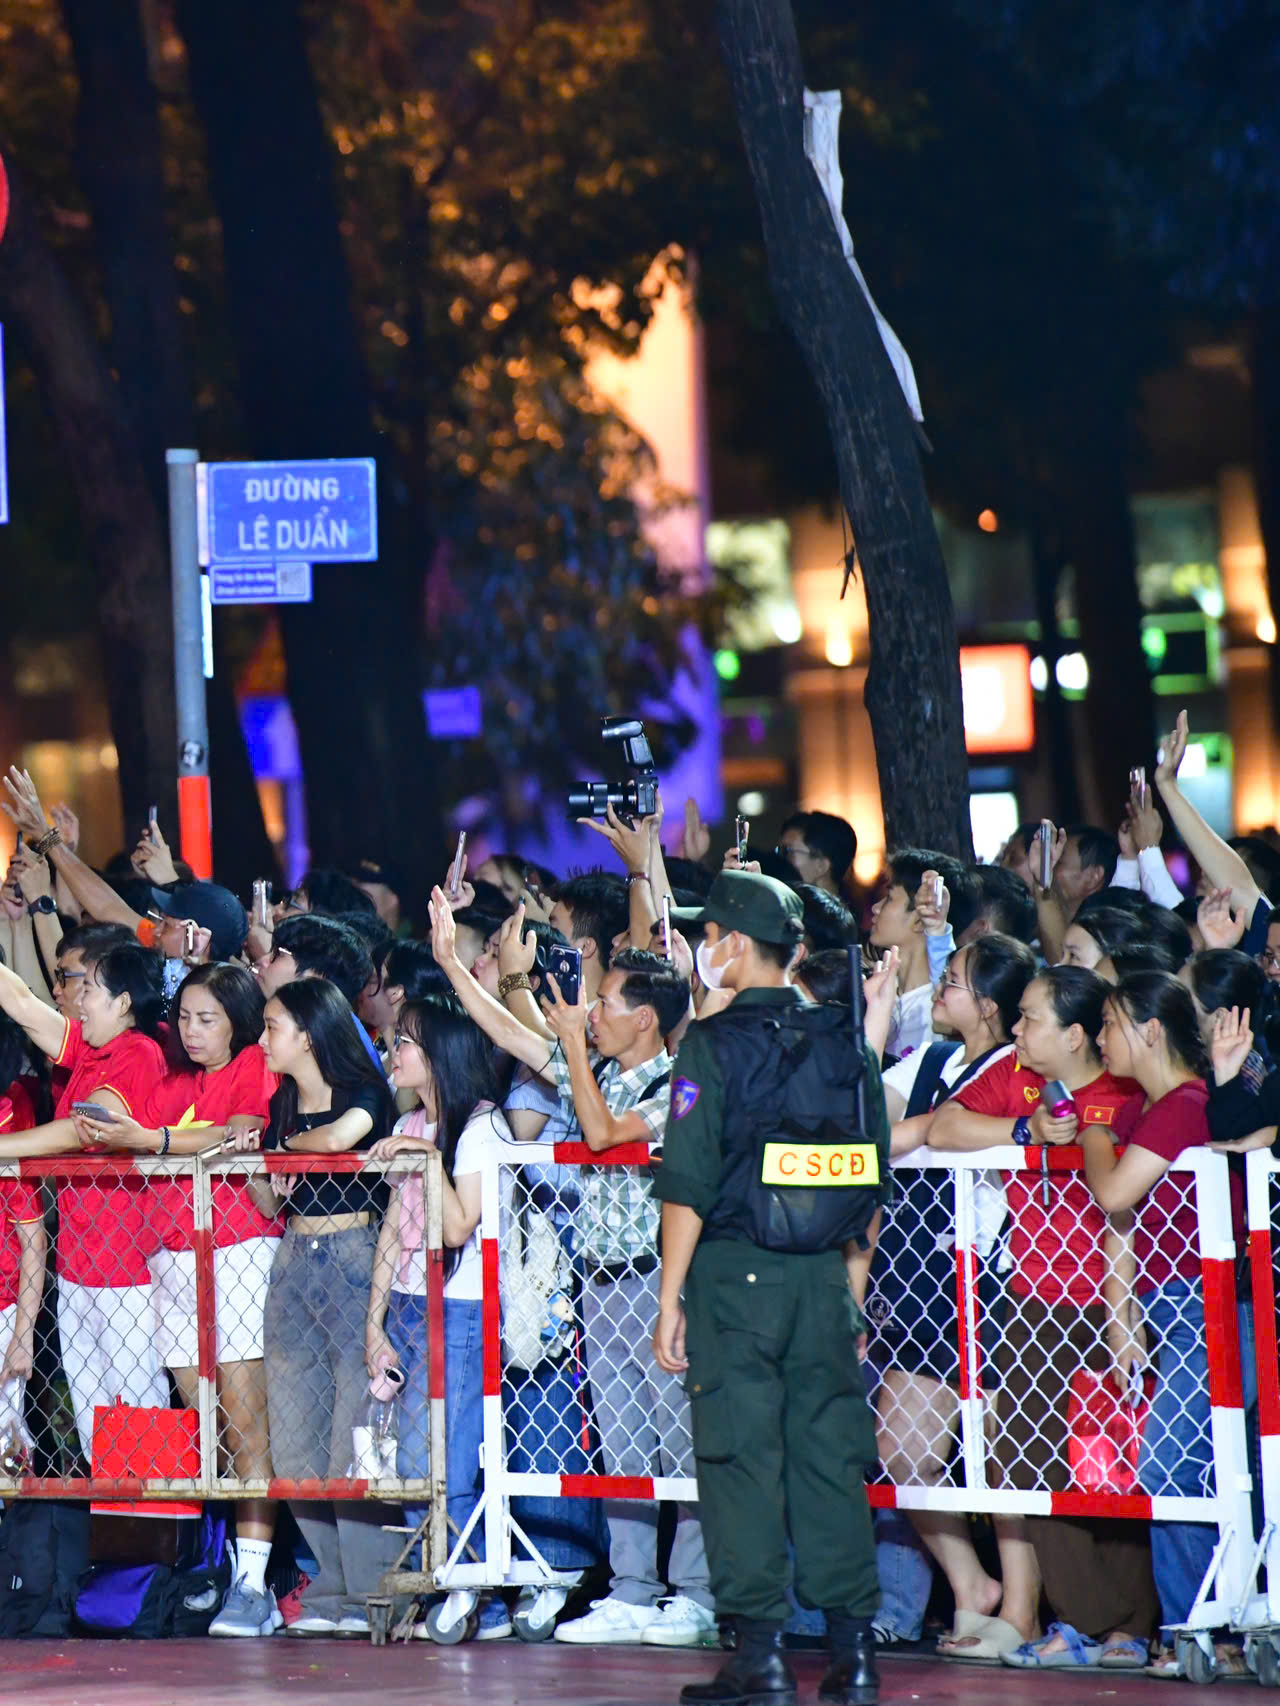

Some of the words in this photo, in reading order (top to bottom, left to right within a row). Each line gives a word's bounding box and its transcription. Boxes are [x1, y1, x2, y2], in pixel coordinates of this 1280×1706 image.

[244, 473, 340, 502] ĐƯỜNG
[238, 514, 270, 550] LÊ
[276, 506, 349, 550] DUẨN
[778, 1152, 865, 1177] CSCĐ
